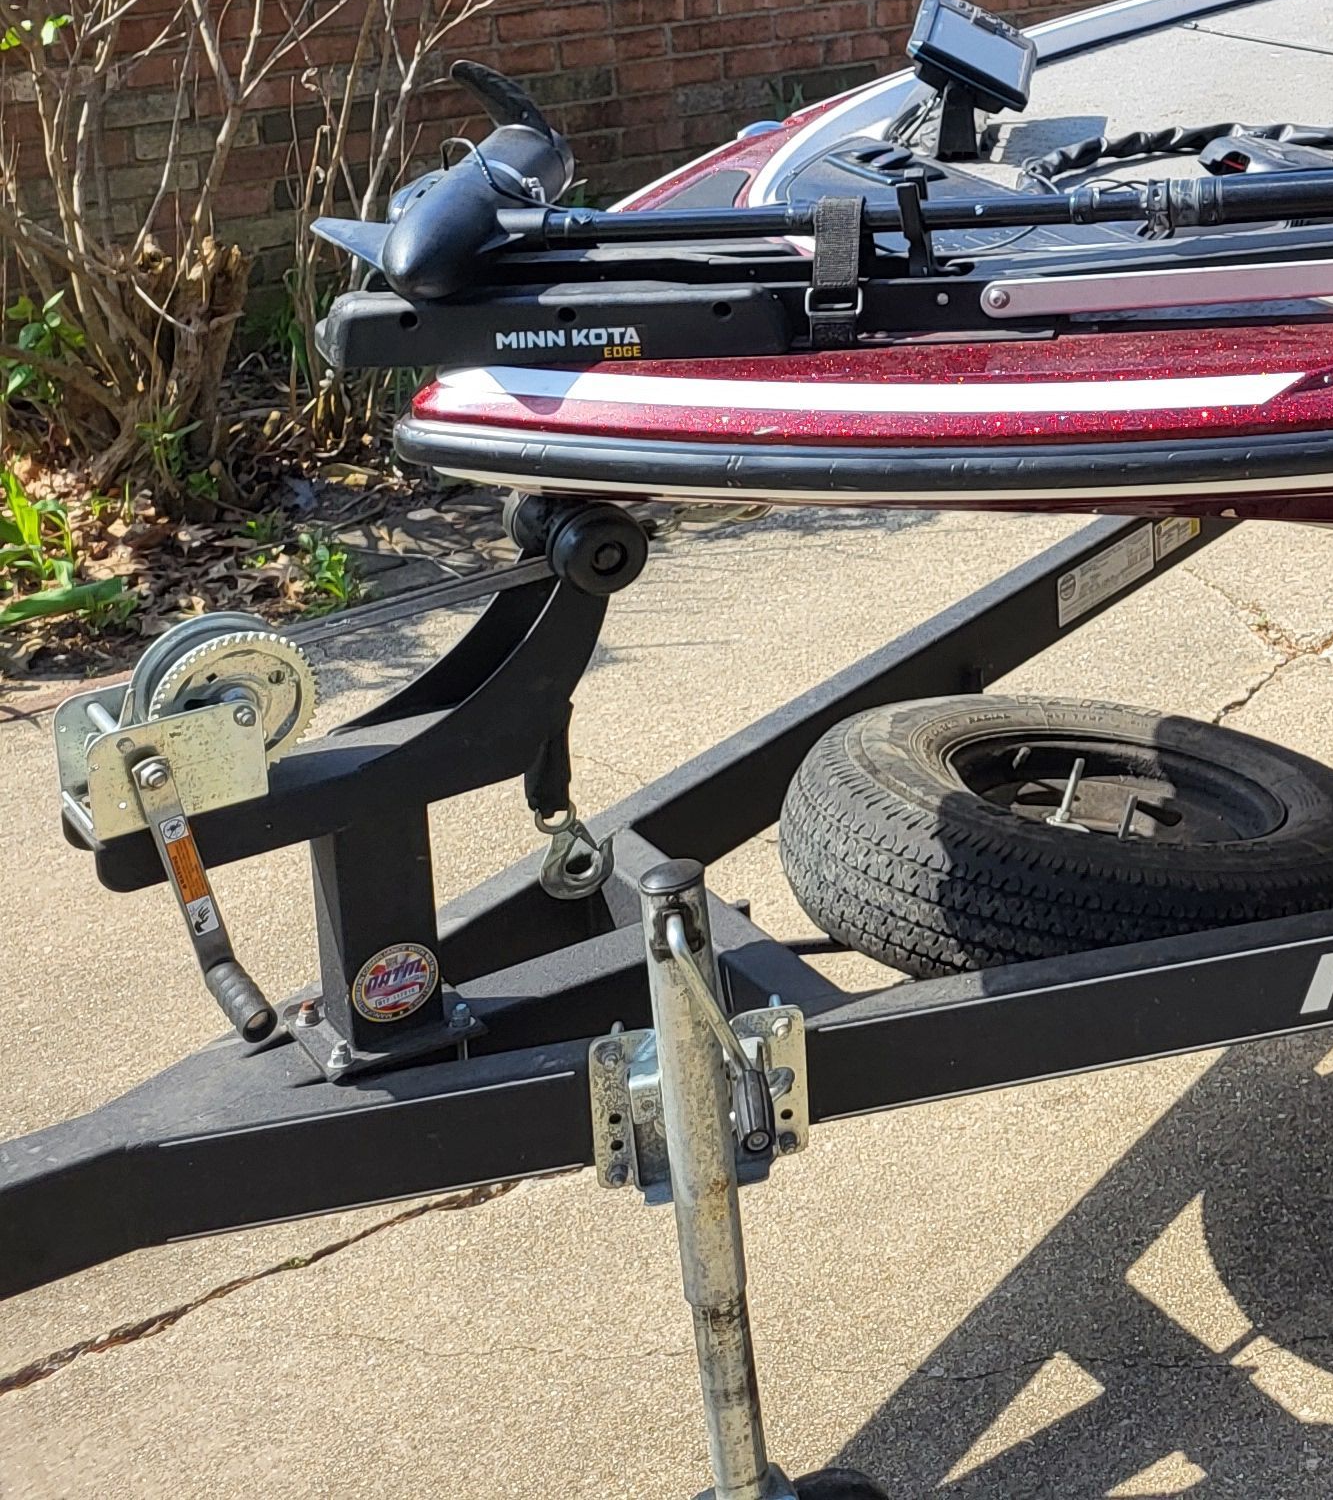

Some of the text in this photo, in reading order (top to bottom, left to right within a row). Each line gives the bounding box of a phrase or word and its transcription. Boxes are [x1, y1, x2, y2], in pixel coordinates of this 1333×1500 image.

[495, 326, 641, 350] MINN KOTA
[603, 345, 642, 358] EDGE
